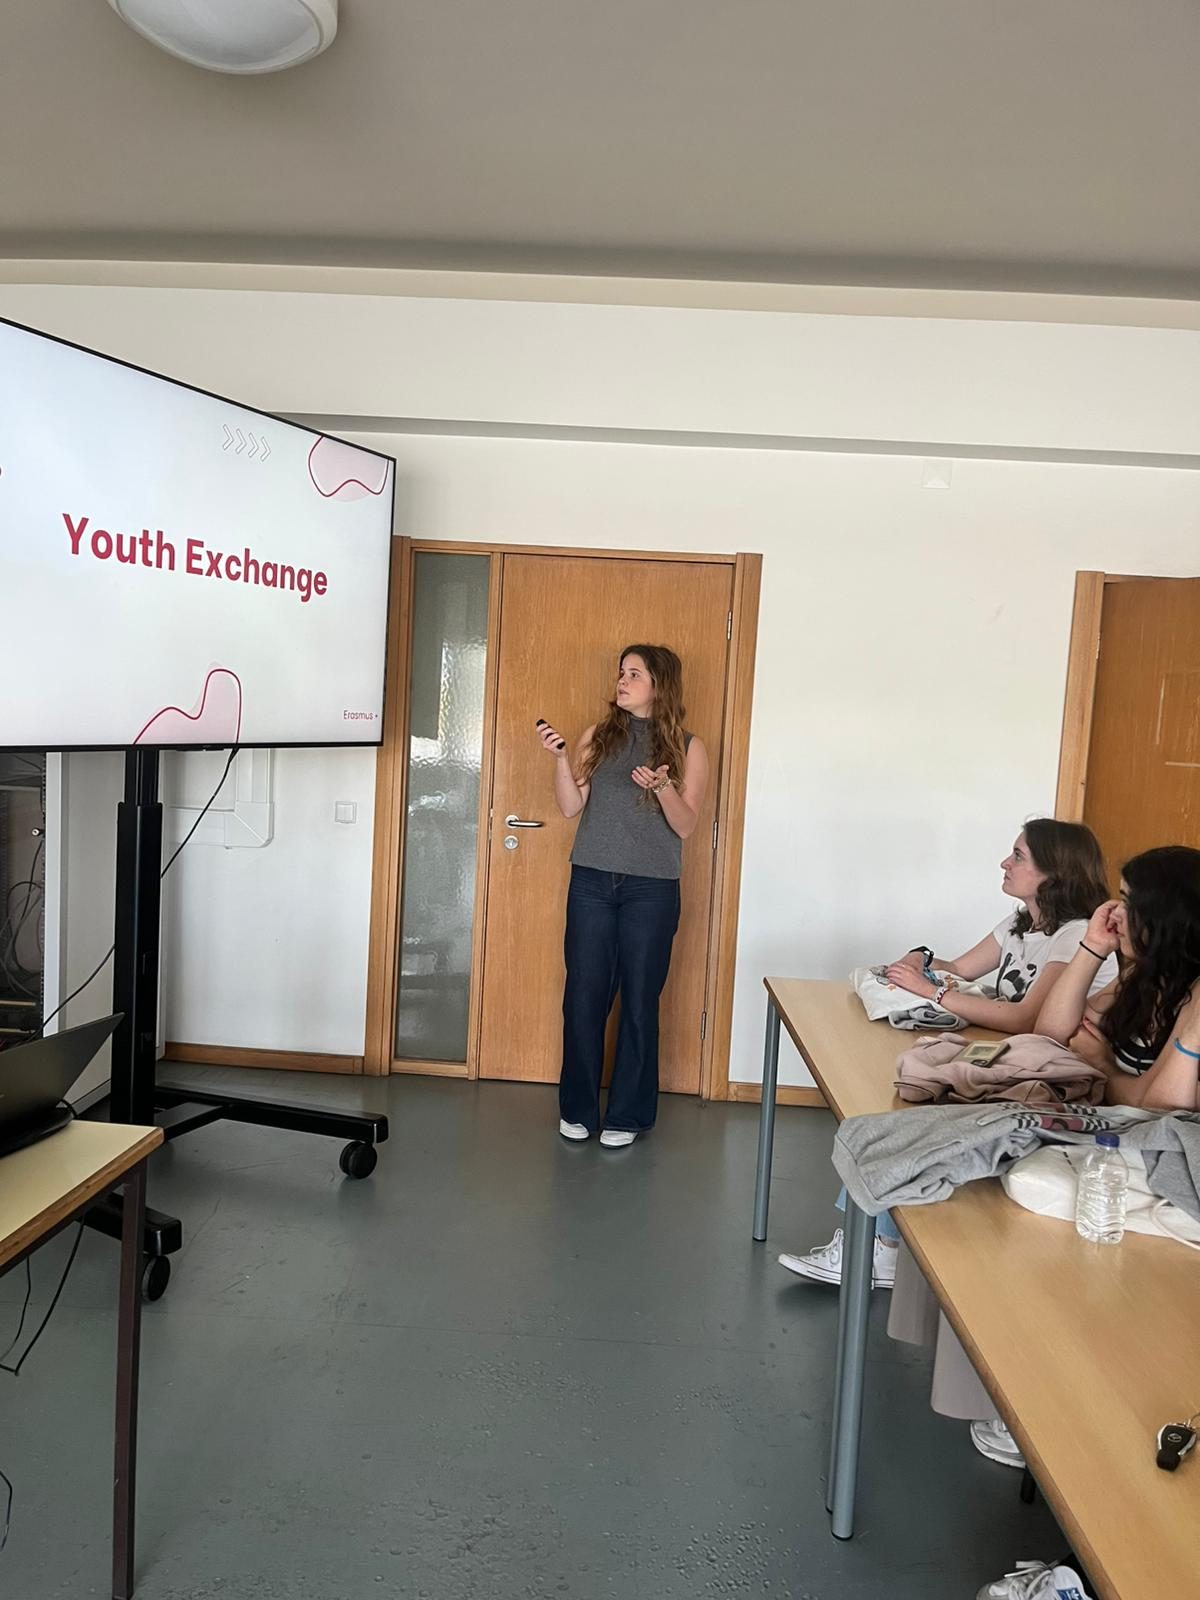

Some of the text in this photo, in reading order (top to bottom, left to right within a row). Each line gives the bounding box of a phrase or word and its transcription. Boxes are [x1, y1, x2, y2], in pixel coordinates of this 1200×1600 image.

[63, 513, 328, 602] Youth Exchange
[343, 709, 374, 720] Erasmus
